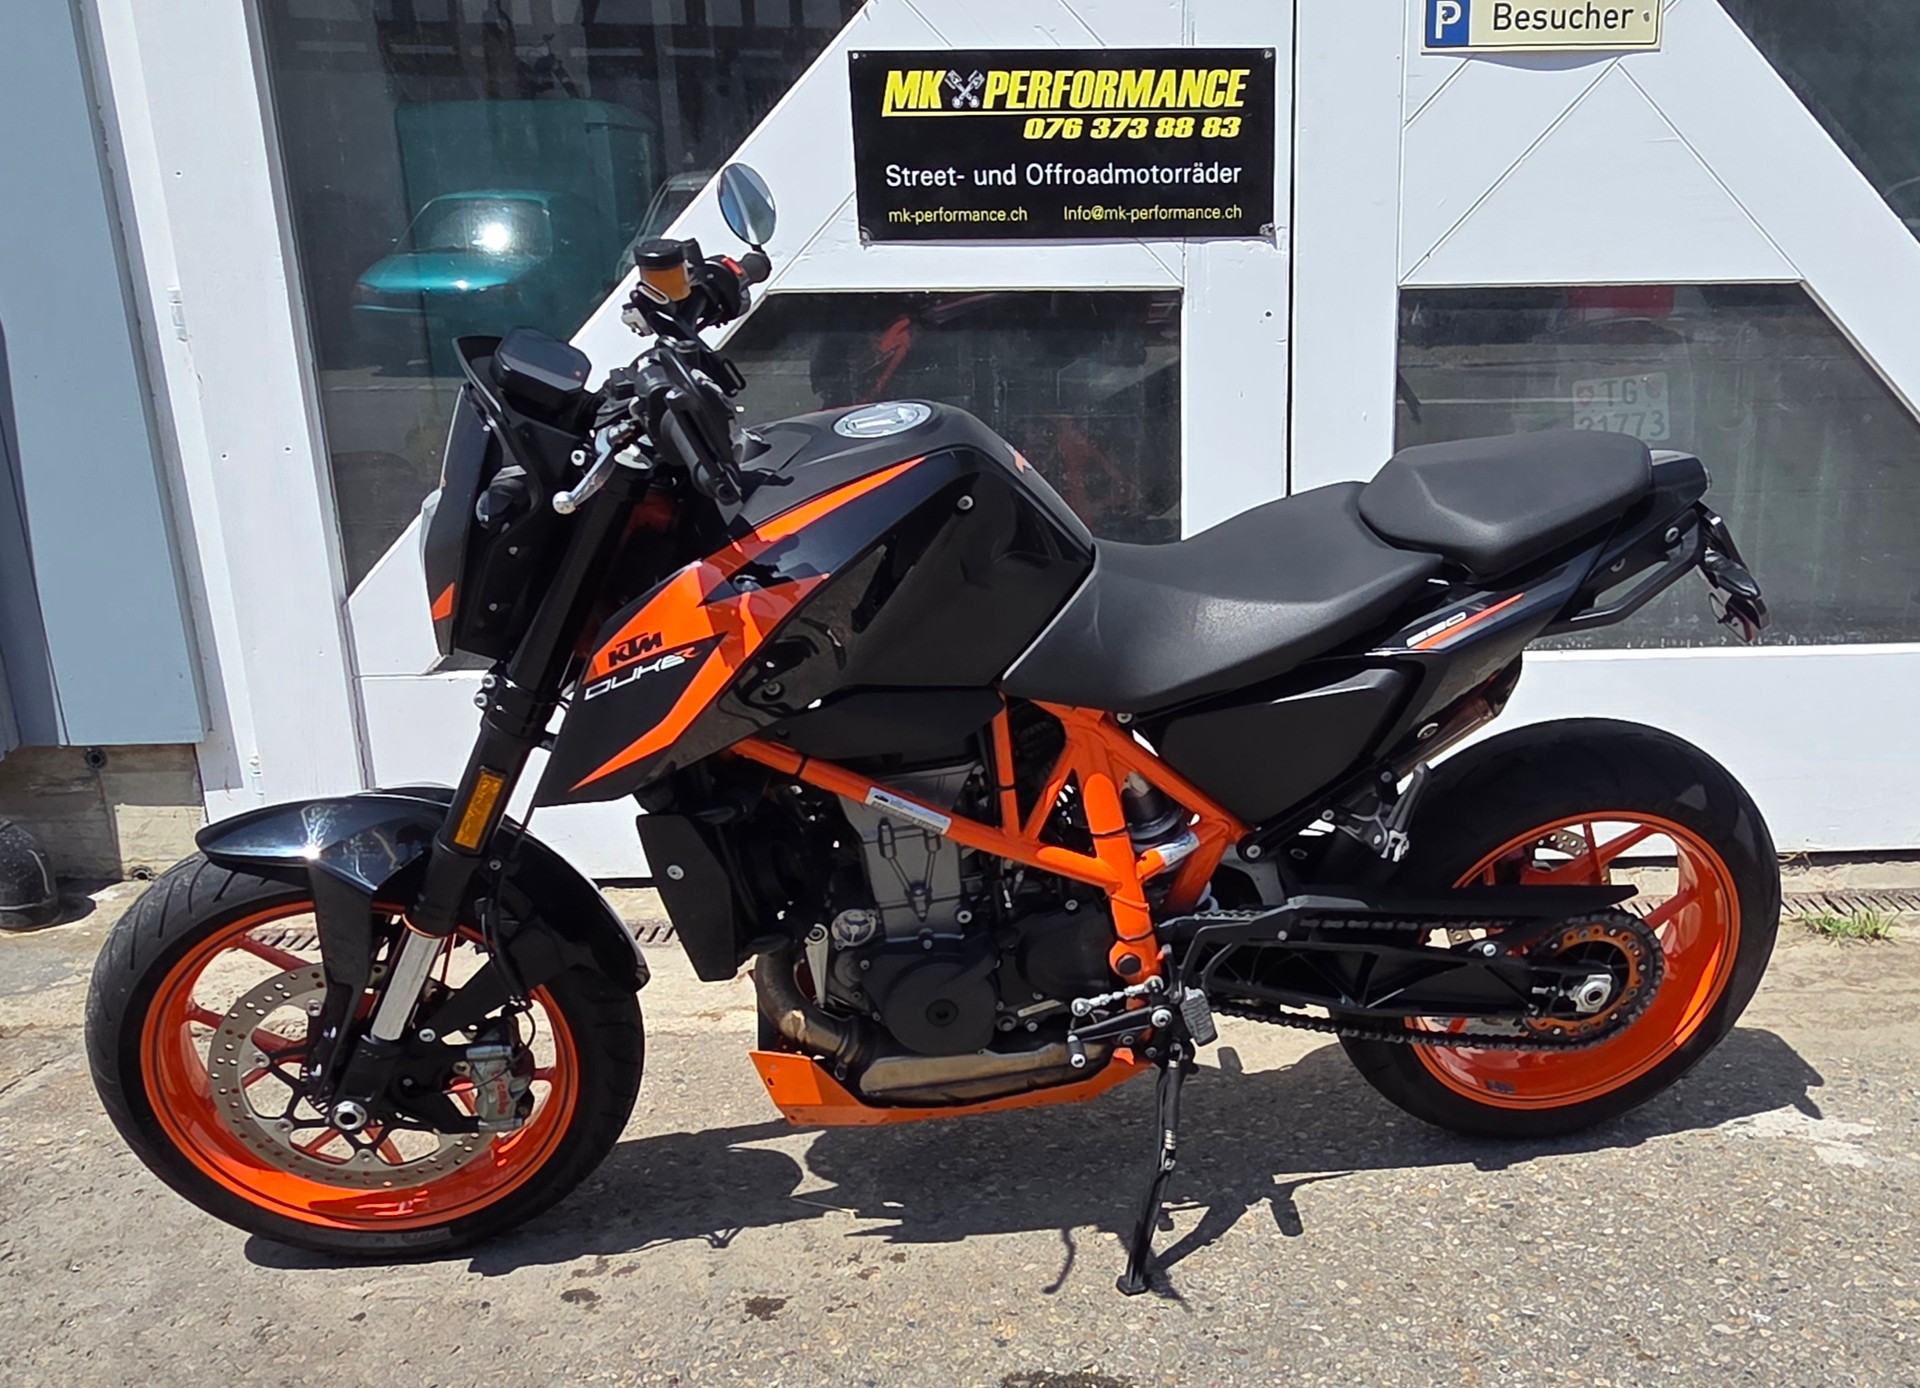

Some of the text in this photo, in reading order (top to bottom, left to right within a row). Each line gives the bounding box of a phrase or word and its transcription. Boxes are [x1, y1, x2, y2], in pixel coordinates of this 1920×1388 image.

[1493, 1, 1634, 31] Besucher
[882, 68, 1250, 113] MK PERFORMANCE
[1023, 117, 1242, 139] 076 373 88 83
[886, 161, 1243, 188] Street- und Offroadmotorräder
[888, 204, 1243, 224] mk-performance.ch Info@mk-performance.ch
[1599, 378, 1639, 407] TG
[608, 631, 663, 668] KTM
